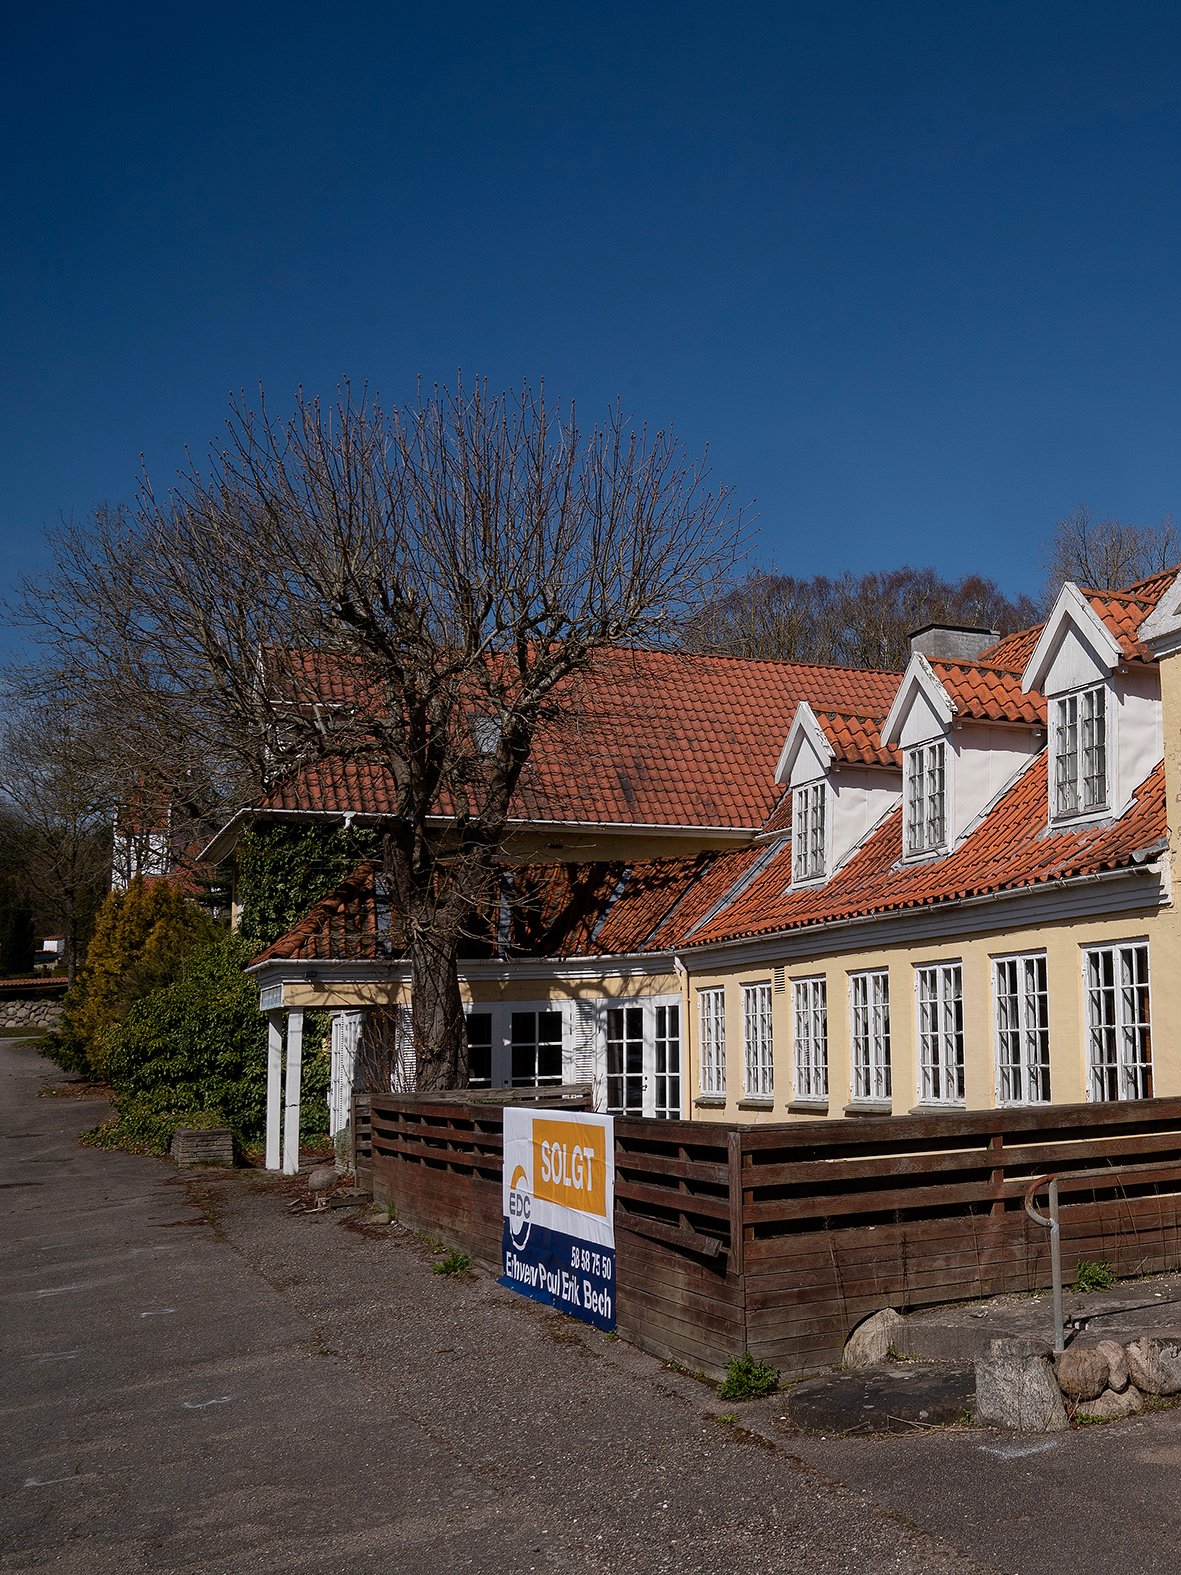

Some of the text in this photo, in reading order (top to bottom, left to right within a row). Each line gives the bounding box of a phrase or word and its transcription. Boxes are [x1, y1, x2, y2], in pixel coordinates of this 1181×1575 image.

[541, 1140, 595, 1192] SOLGT
[509, 1192, 531, 1220] EDC
[570, 1246, 612, 1280] 58 58 75 50
[561, 1270, 581, 1306] Erik
[583, 1279, 612, 1319] Bech
